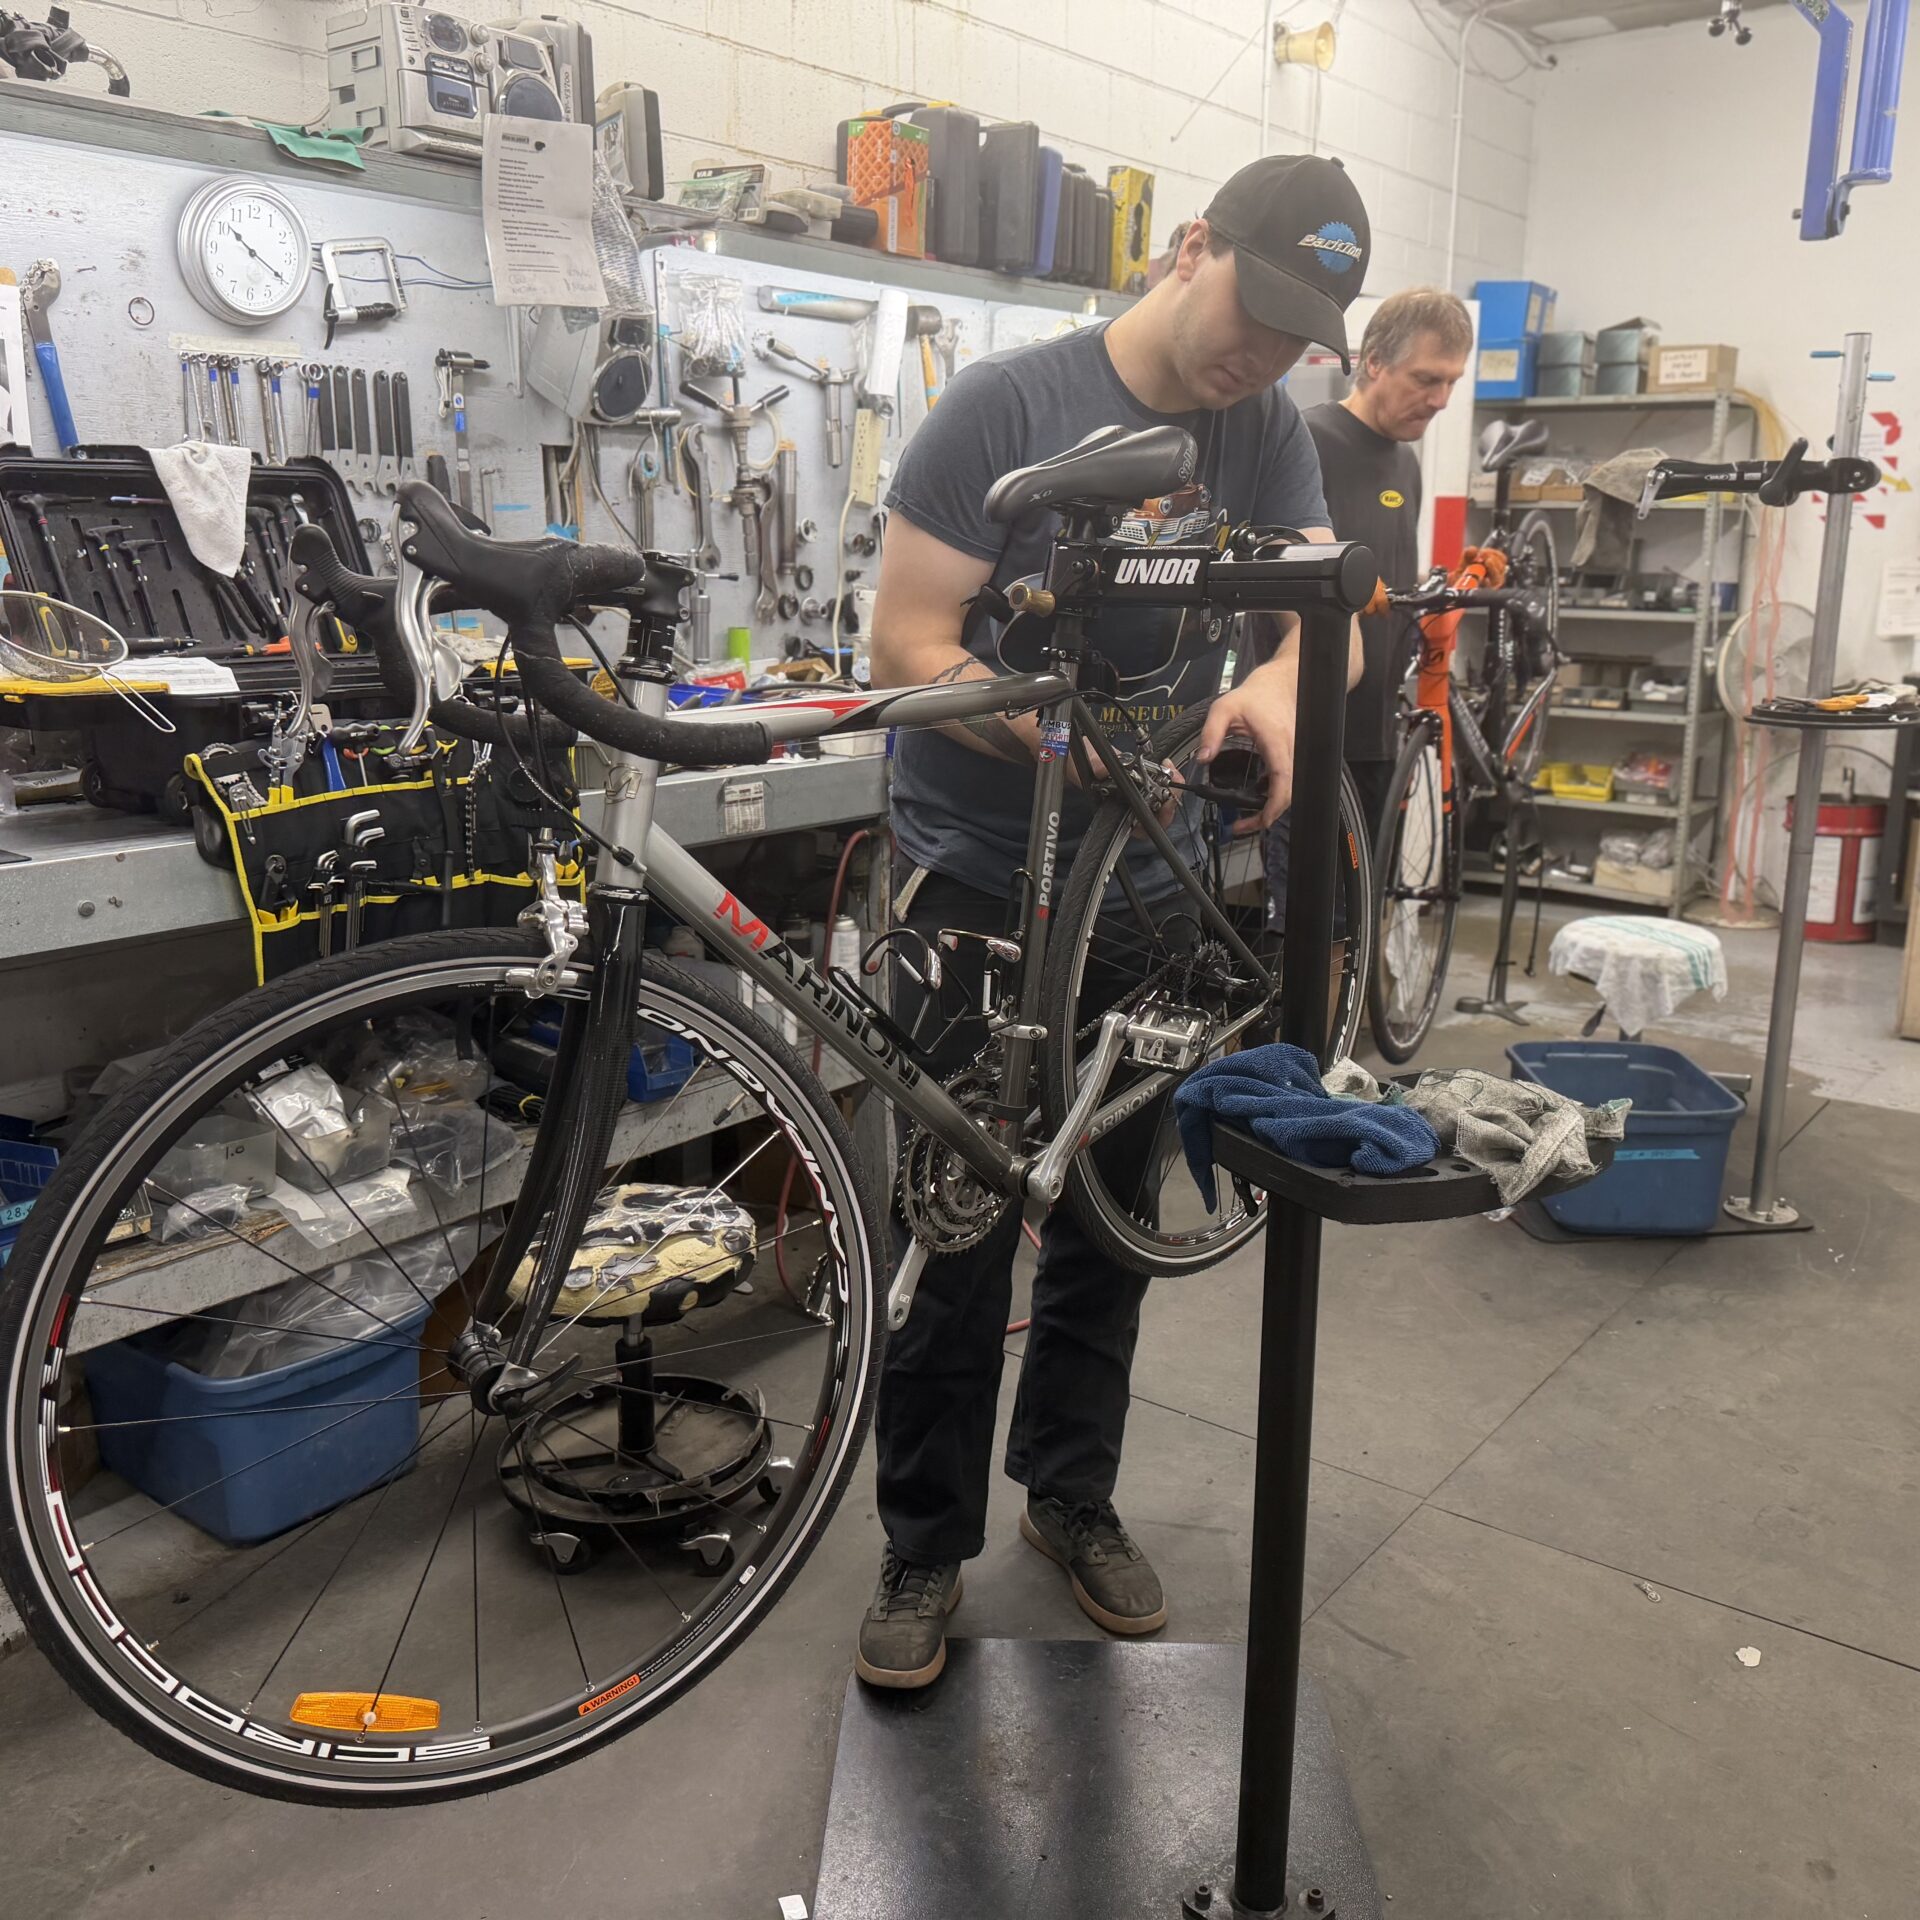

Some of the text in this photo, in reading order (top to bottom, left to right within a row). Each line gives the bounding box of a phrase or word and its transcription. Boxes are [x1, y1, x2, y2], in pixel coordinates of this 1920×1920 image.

[696, 170, 713, 179] VAR
[231, 208, 242, 222] 11
[248, 205, 261, 219] 12
[268, 214, 273, 228] 1
[218, 221, 230, 236] 10
[279, 231, 287, 244] 2
[210, 240, 218, 254] 9
[284, 252, 292, 266] 3
[215, 263, 224, 277] 8
[230, 280, 238, 294] 7
[246, 287, 254, 301] 6
[264, 284, 272, 298] 5
[1114, 558, 1201, 585] UNIOR
[1037, 811, 1060, 919] SPORTIVO
[713, 889, 921, 1090] MARINONI
[225, 1145, 246, 1160] 1.0
[47, 1490, 494, 1762] SCIROCCO
[590, 1677, 638, 1708] WARNING!
